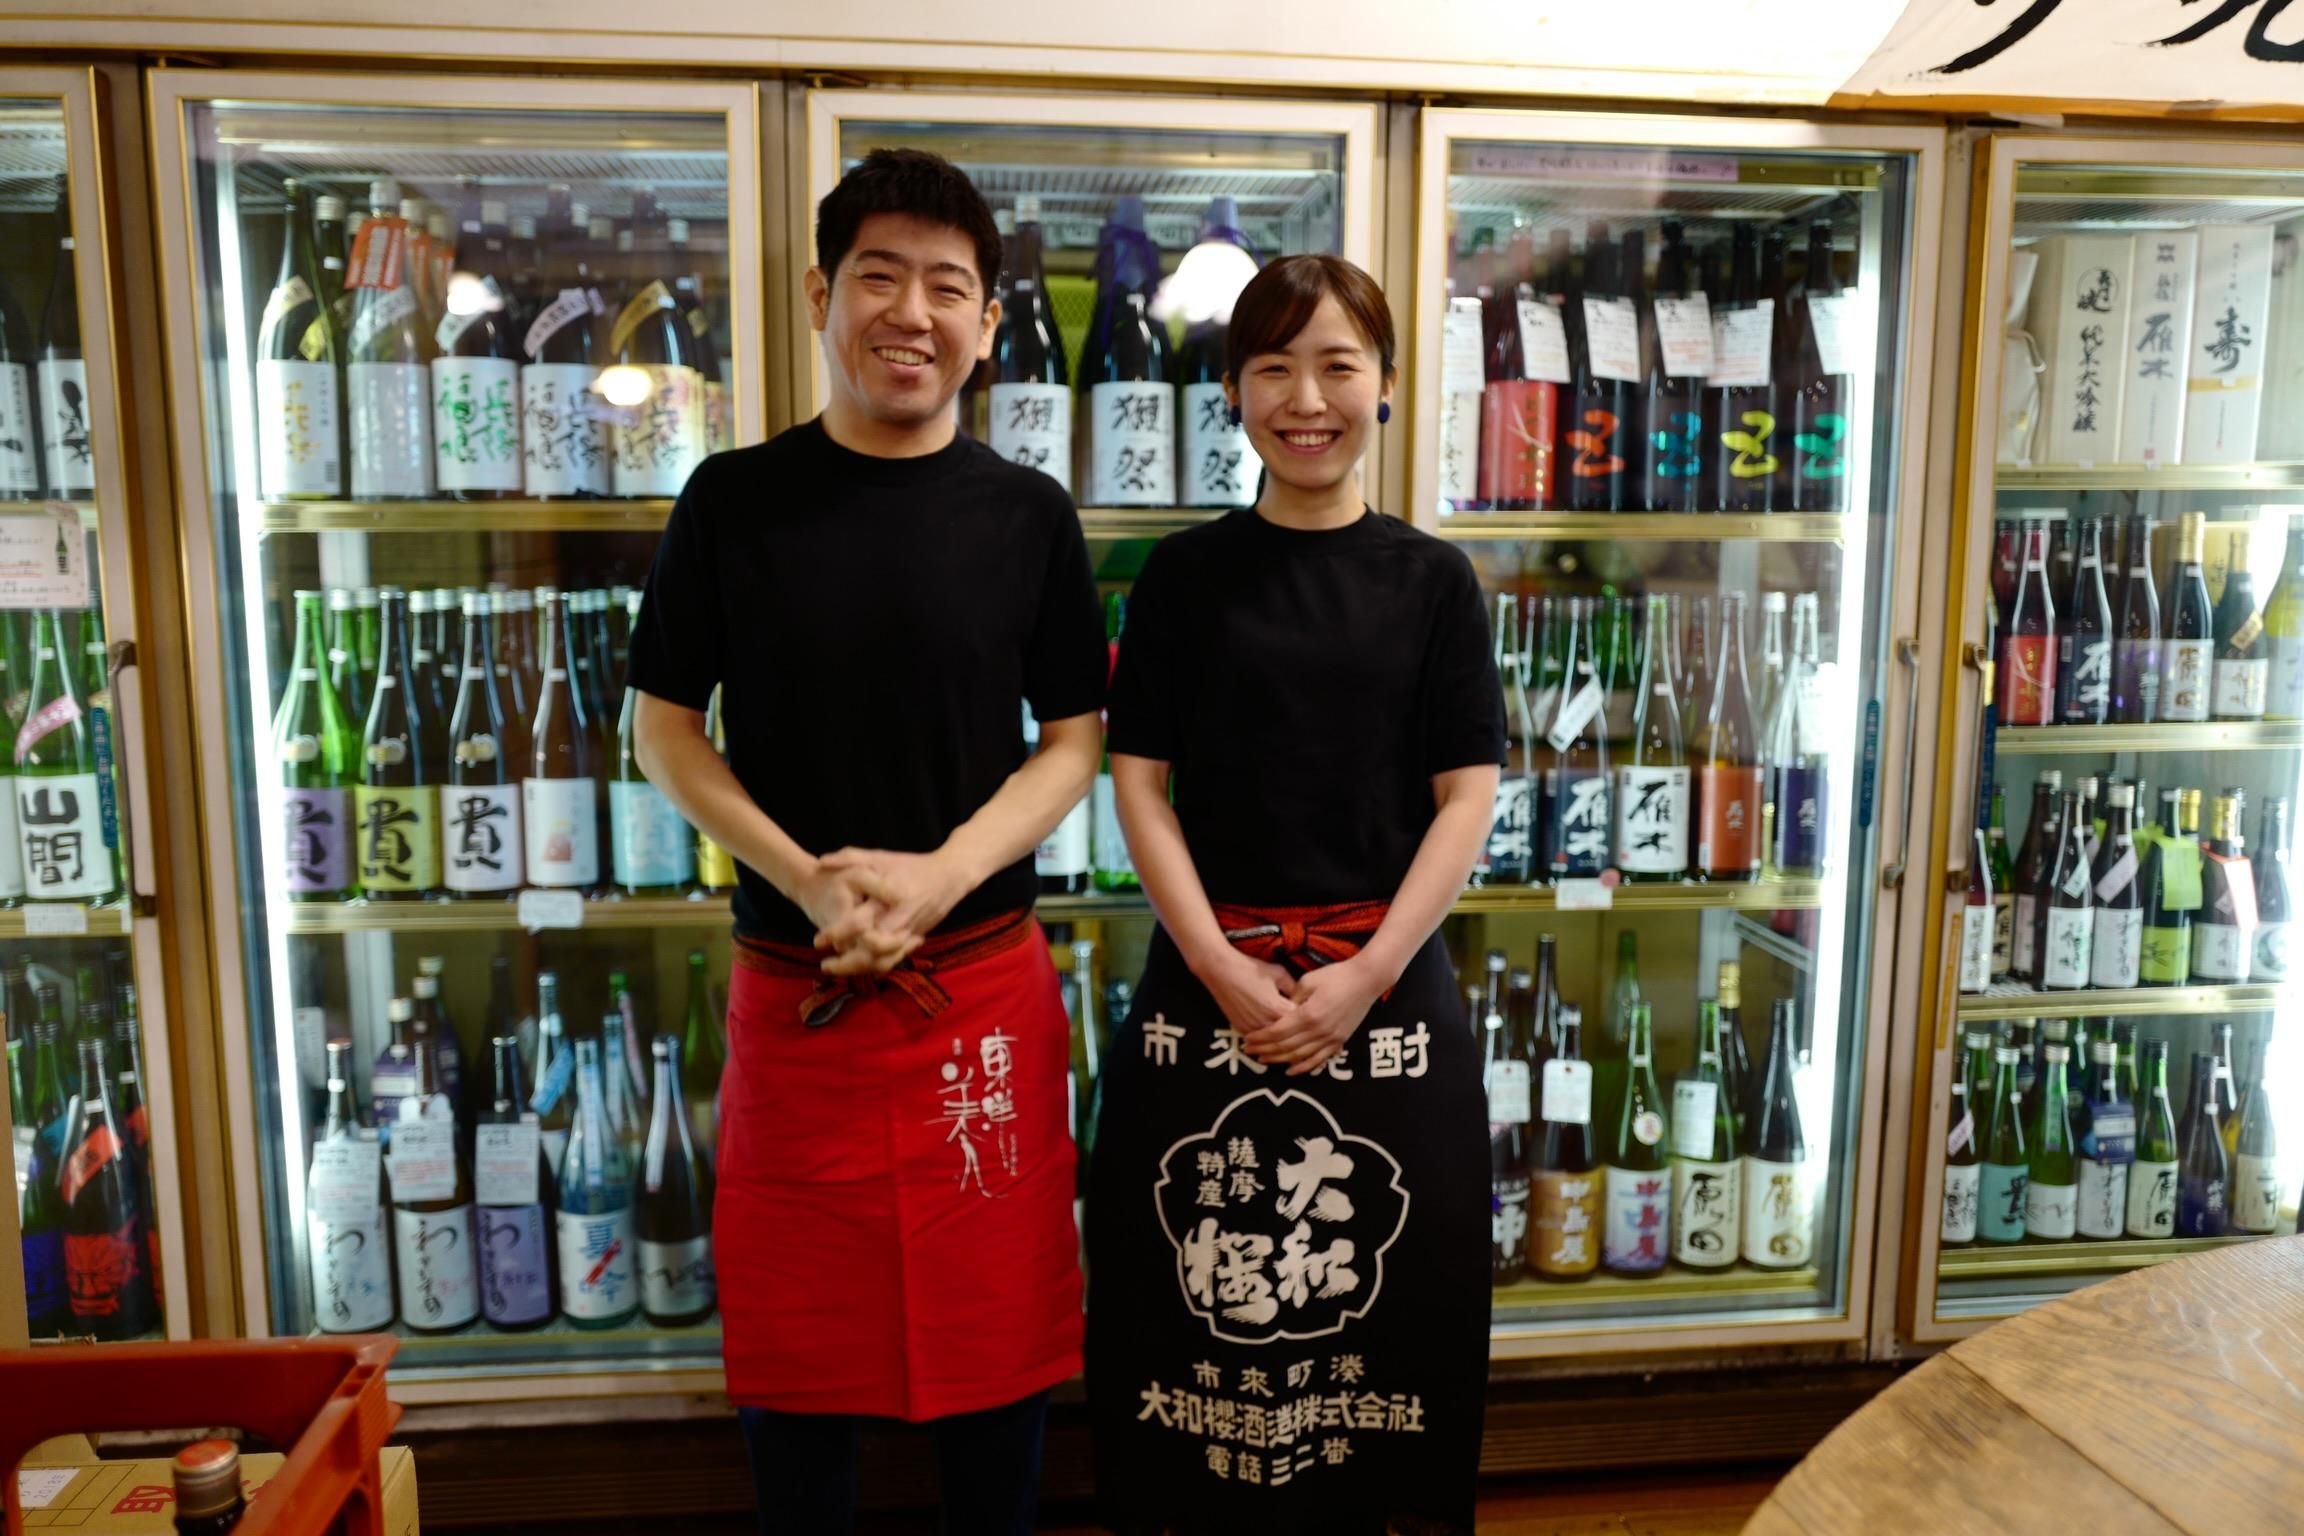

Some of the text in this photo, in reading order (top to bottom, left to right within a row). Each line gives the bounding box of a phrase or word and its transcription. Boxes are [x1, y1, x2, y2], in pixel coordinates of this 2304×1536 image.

[2136, 313, 2174, 379] 雁木
[2204, 306, 2251, 374] 寿
[1111, 394, 1161, 491] 獺祭
[21, 788, 83, 885] 山間
[358, 797, 421, 882] 貴
[450, 796, 508, 870] 貴
[1628, 780, 1674, 855] 雁木
